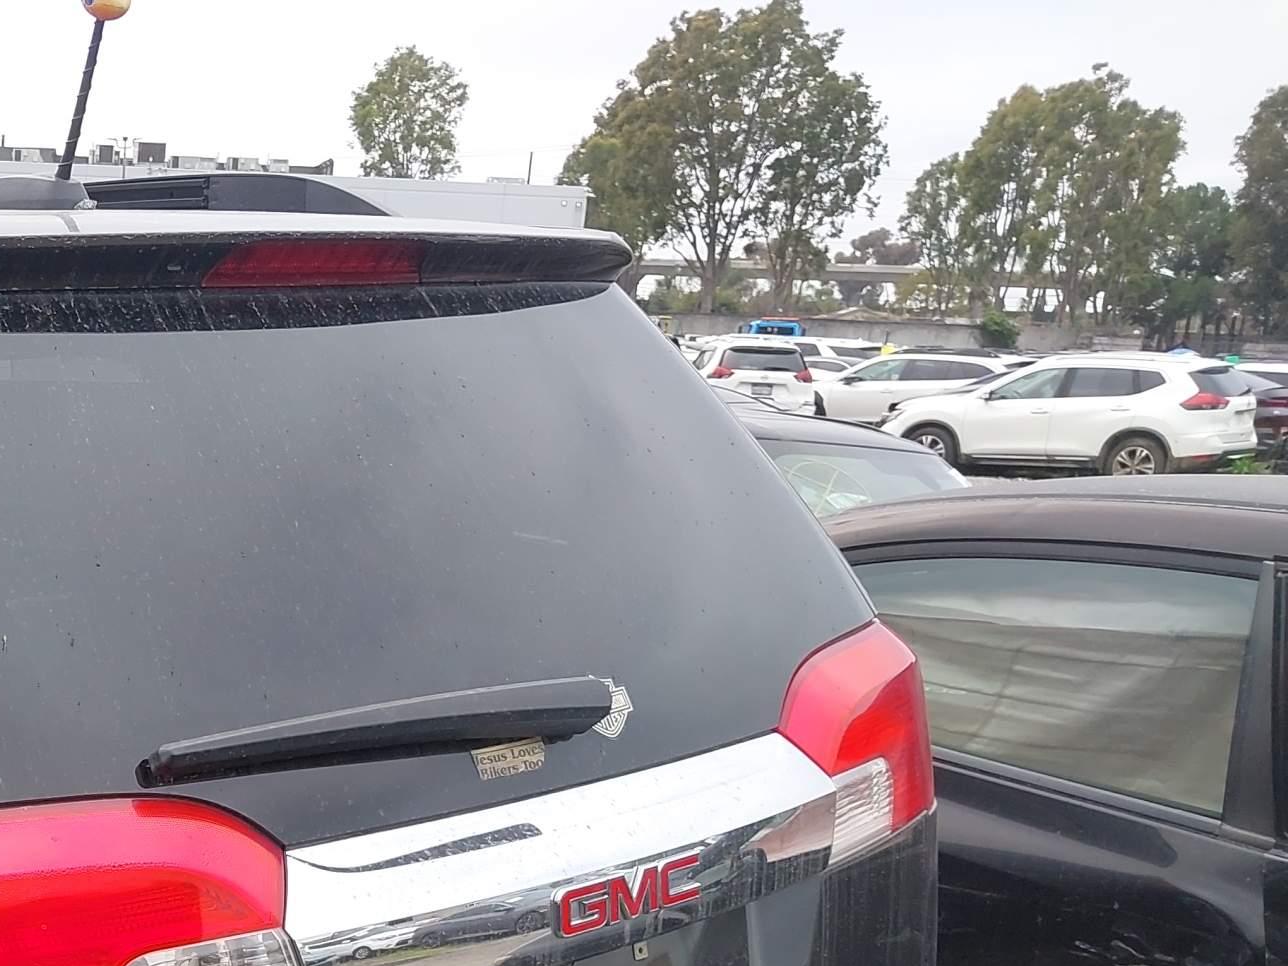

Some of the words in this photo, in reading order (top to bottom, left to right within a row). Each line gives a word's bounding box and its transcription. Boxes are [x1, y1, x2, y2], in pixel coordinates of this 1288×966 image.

[475, 752, 508, 767] Jesus
[480, 763, 520, 779] Bikers
[521, 758, 545, 771] Too
[550, 846, 702, 938] GMC
